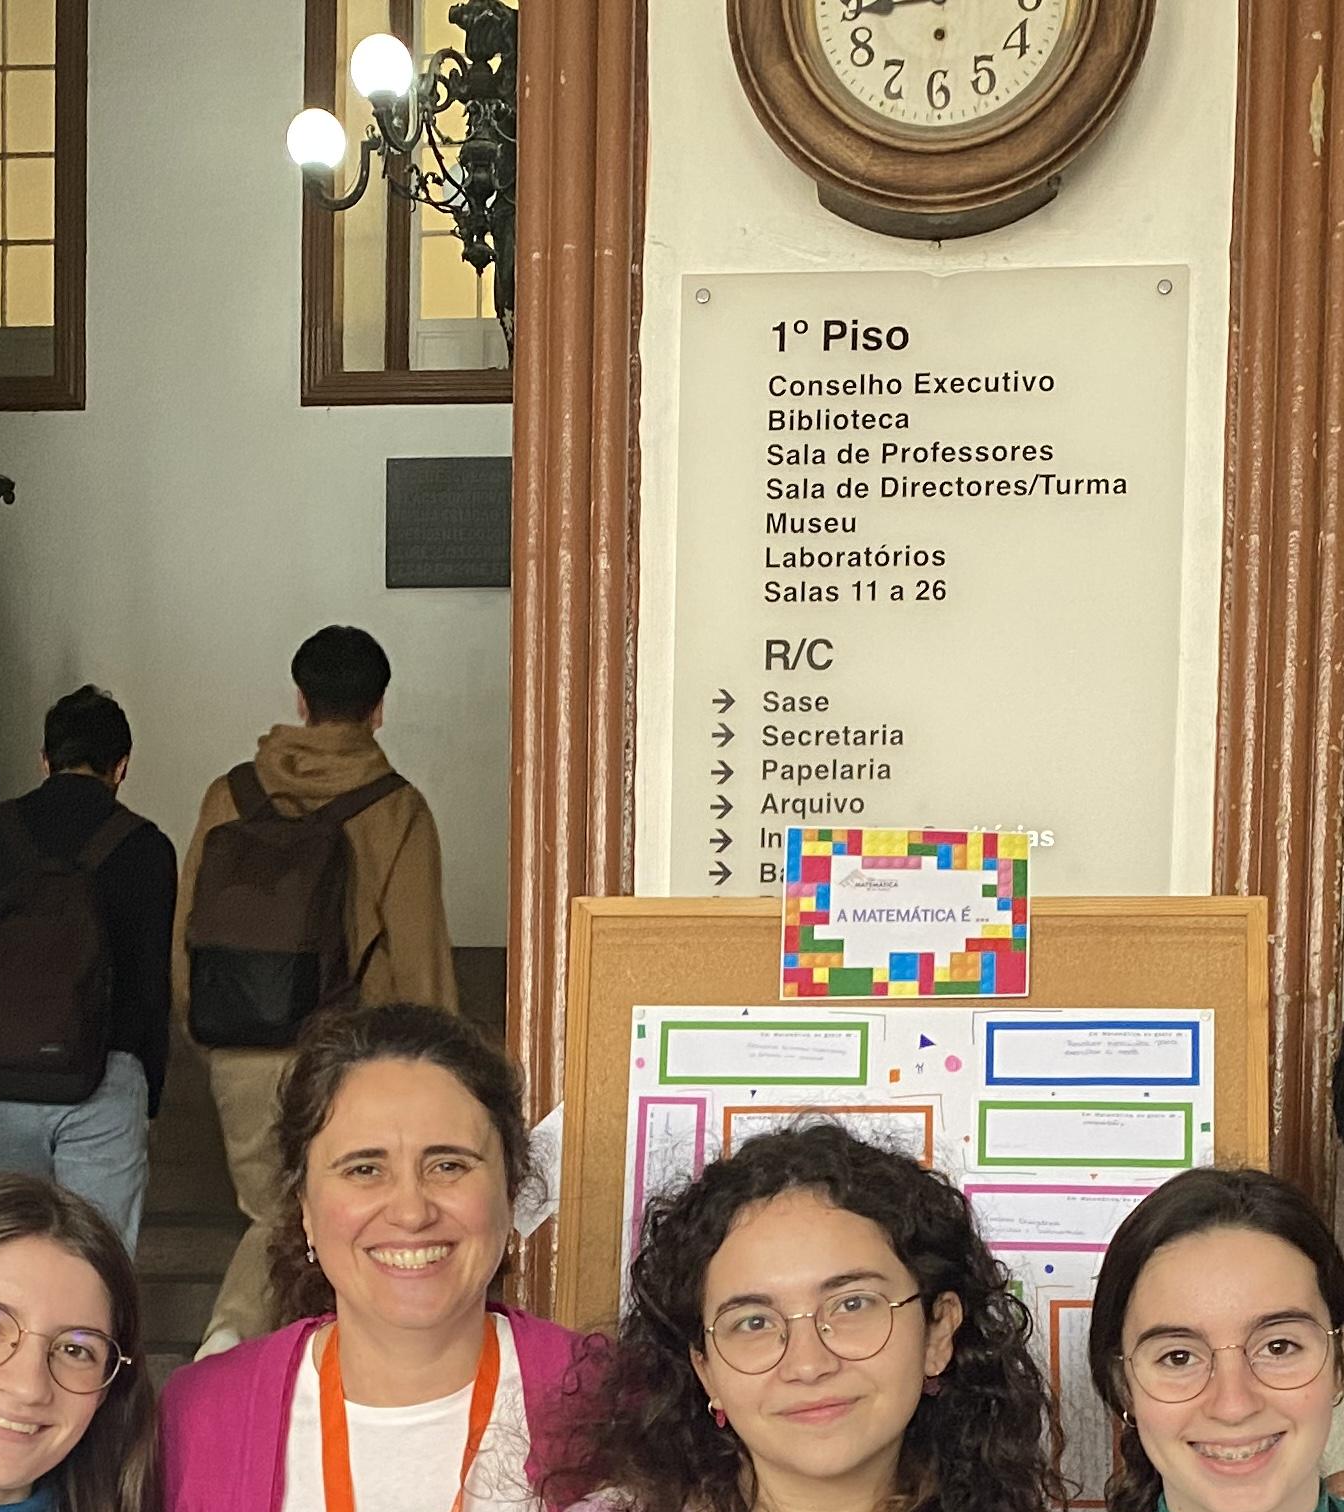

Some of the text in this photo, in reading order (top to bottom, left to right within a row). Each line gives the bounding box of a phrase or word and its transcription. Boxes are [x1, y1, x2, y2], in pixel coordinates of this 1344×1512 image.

[850, 26, 875, 68] 8
[1002, 17, 1030, 60] 4
[883, 58, 905, 101] 7
[969, 54, 997, 96] 5
[926, 69, 951, 110] 6
[823, 319, 909, 352] Piso
[768, 370, 1055, 397] Conselho Executivo
[768, 408, 909, 431] Biblioteca
[767, 441, 1054, 466] Sala de Professores
[766, 473, 1127, 500] Sala de Directores/Turma
[766, 512, 856, 534] Museu
[765, 544, 946, 569] Laboratórios
[764, 579, 947, 603] Salas 11 a 26
[765, 637, 834, 671] R/C
[763, 690, 829, 713] Sase
[762, 723, 903, 747] Secretaria
[762, 758, 891, 786] Papelaria
[760, 792, 865, 820] Arquivo
[836, 908, 849, 923] A
[852, 903, 957, 923] MATEMÁTICA
[961, 903, 972, 923] É
